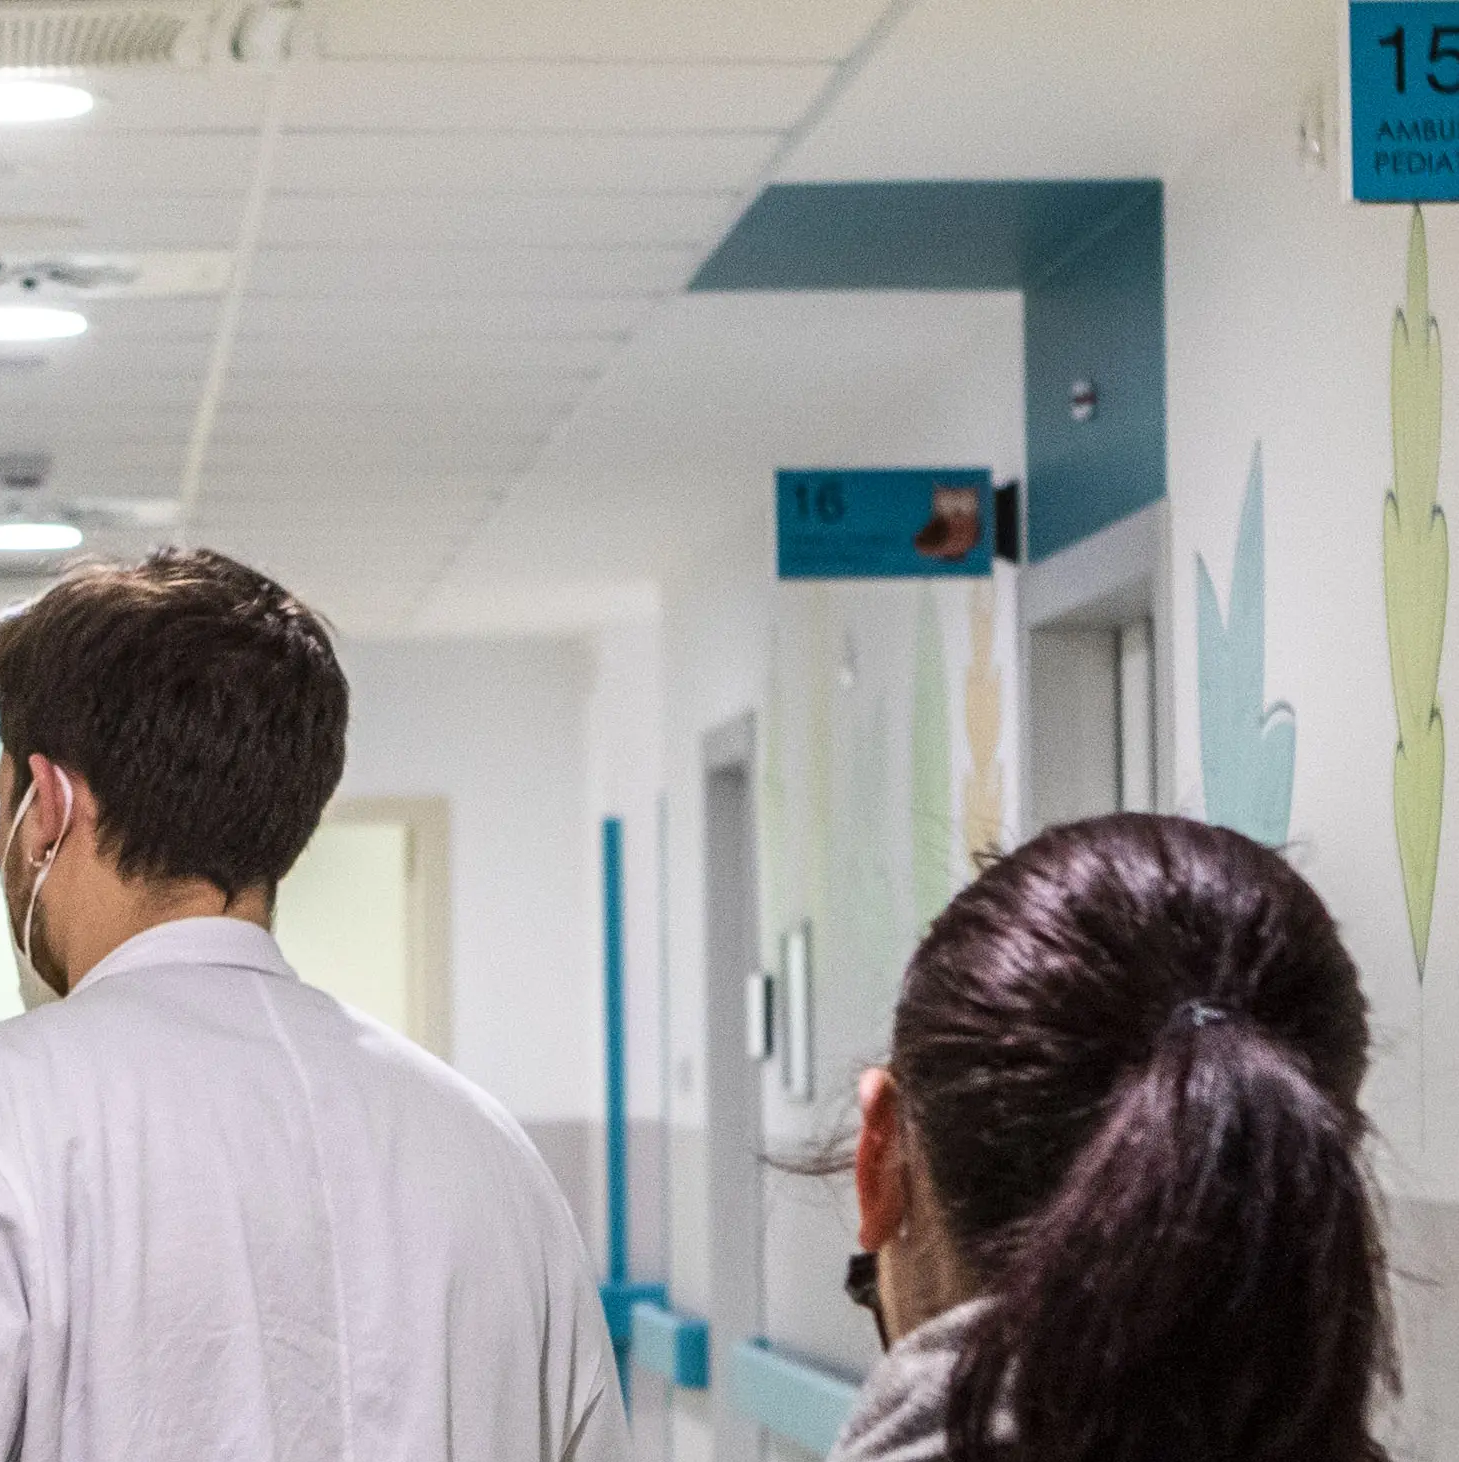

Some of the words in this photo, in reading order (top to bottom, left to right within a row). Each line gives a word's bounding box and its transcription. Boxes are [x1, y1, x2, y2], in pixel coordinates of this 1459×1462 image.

[1378, 25, 1459, 94] 15
[1377, 119, 1459, 141] AMBU
[1373, 151, 1459, 175] PEDIA
[795, 481, 844, 523] 16
